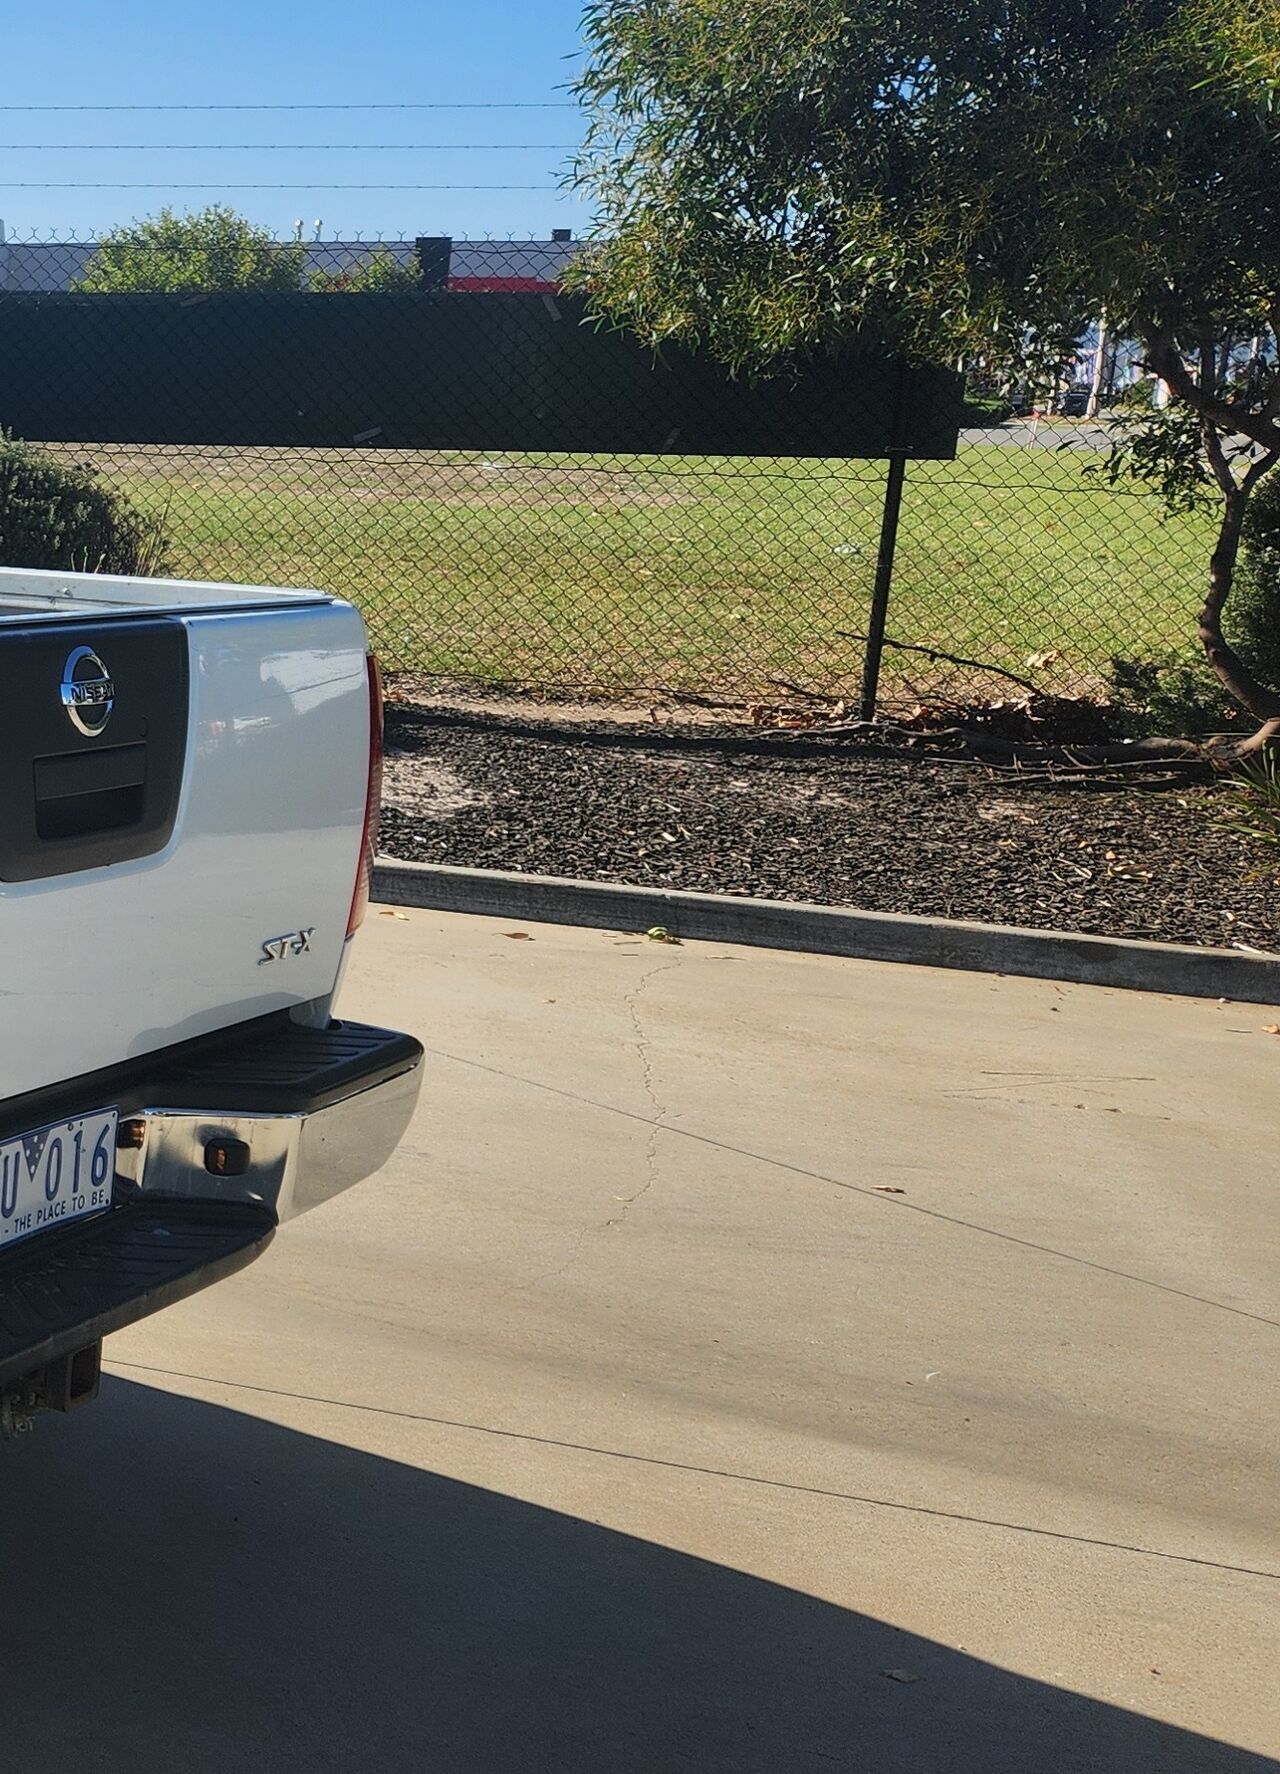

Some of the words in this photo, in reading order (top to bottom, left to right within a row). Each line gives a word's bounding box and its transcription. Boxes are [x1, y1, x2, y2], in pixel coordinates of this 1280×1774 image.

[70, 682, 115, 702] NISSAN
[256, 927, 316, 966] ST-X
[45, 1123, 111, 1202] 016
[14, 1213, 32, 1234] THE
[36, 1202, 67, 1224] PLACE
[72, 1196, 86, 1212] TO
